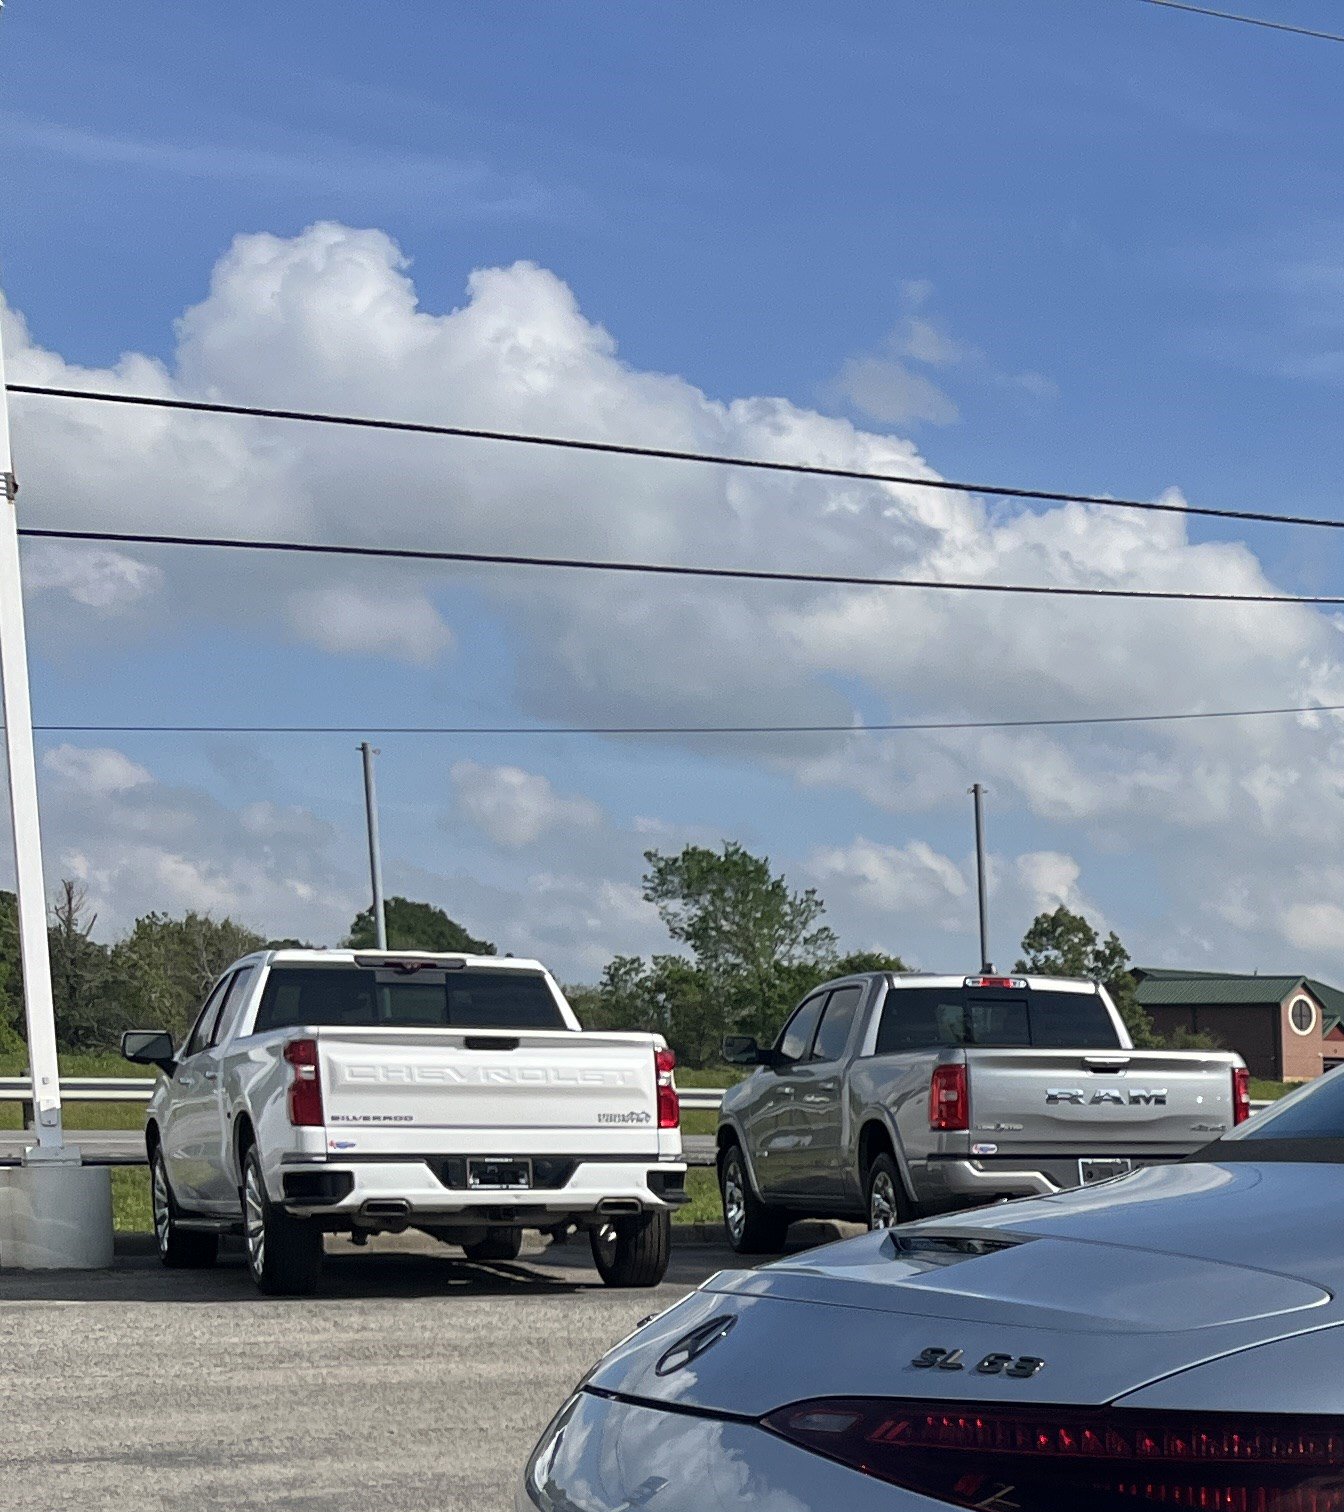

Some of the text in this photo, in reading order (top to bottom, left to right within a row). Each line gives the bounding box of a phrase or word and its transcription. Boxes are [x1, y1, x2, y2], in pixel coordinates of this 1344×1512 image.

[344, 1064, 634, 1086] CHEVROLET
[1046, 1088, 1168, 1105] RAM
[911, 1347, 1045, 1378] SL 63
